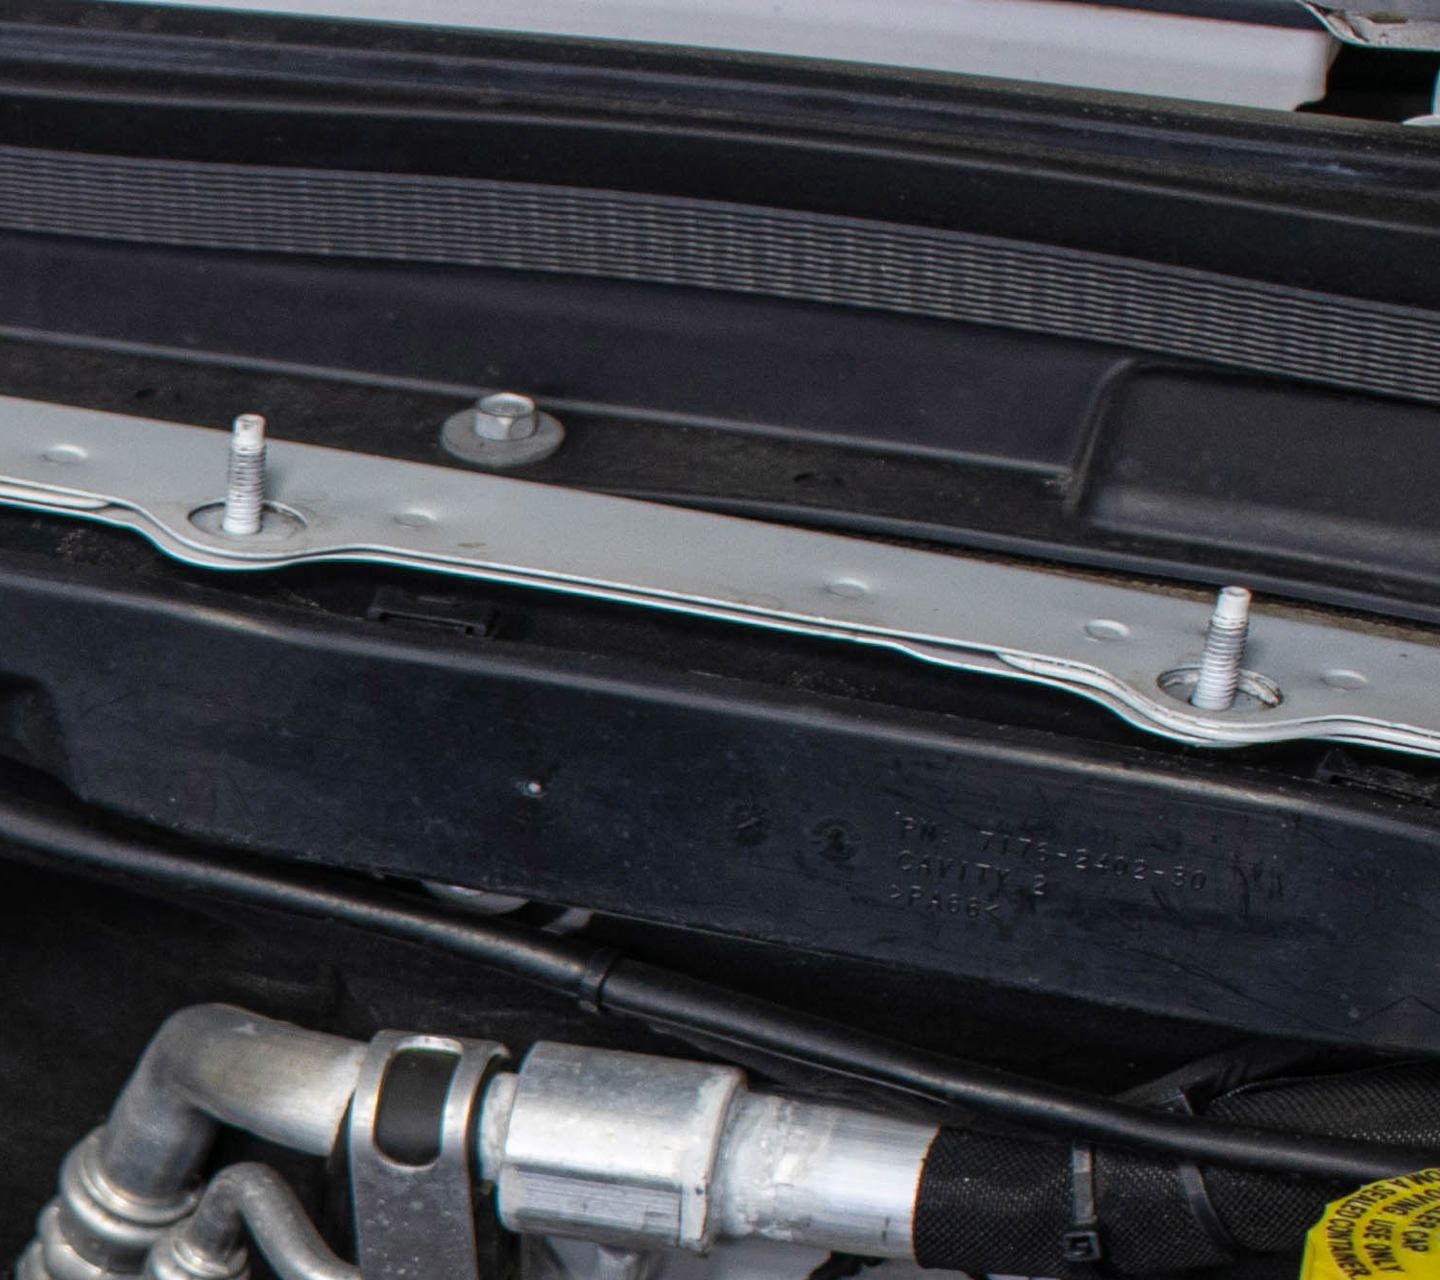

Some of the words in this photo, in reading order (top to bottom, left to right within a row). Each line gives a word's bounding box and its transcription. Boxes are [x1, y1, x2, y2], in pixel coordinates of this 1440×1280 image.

[1376, 1188, 1440, 1216] OVING.
[1363, 1218, 1397, 1241] USE
[1401, 1230, 1430, 1252] CAP
[1363, 1243, 1406, 1273] ONLY
